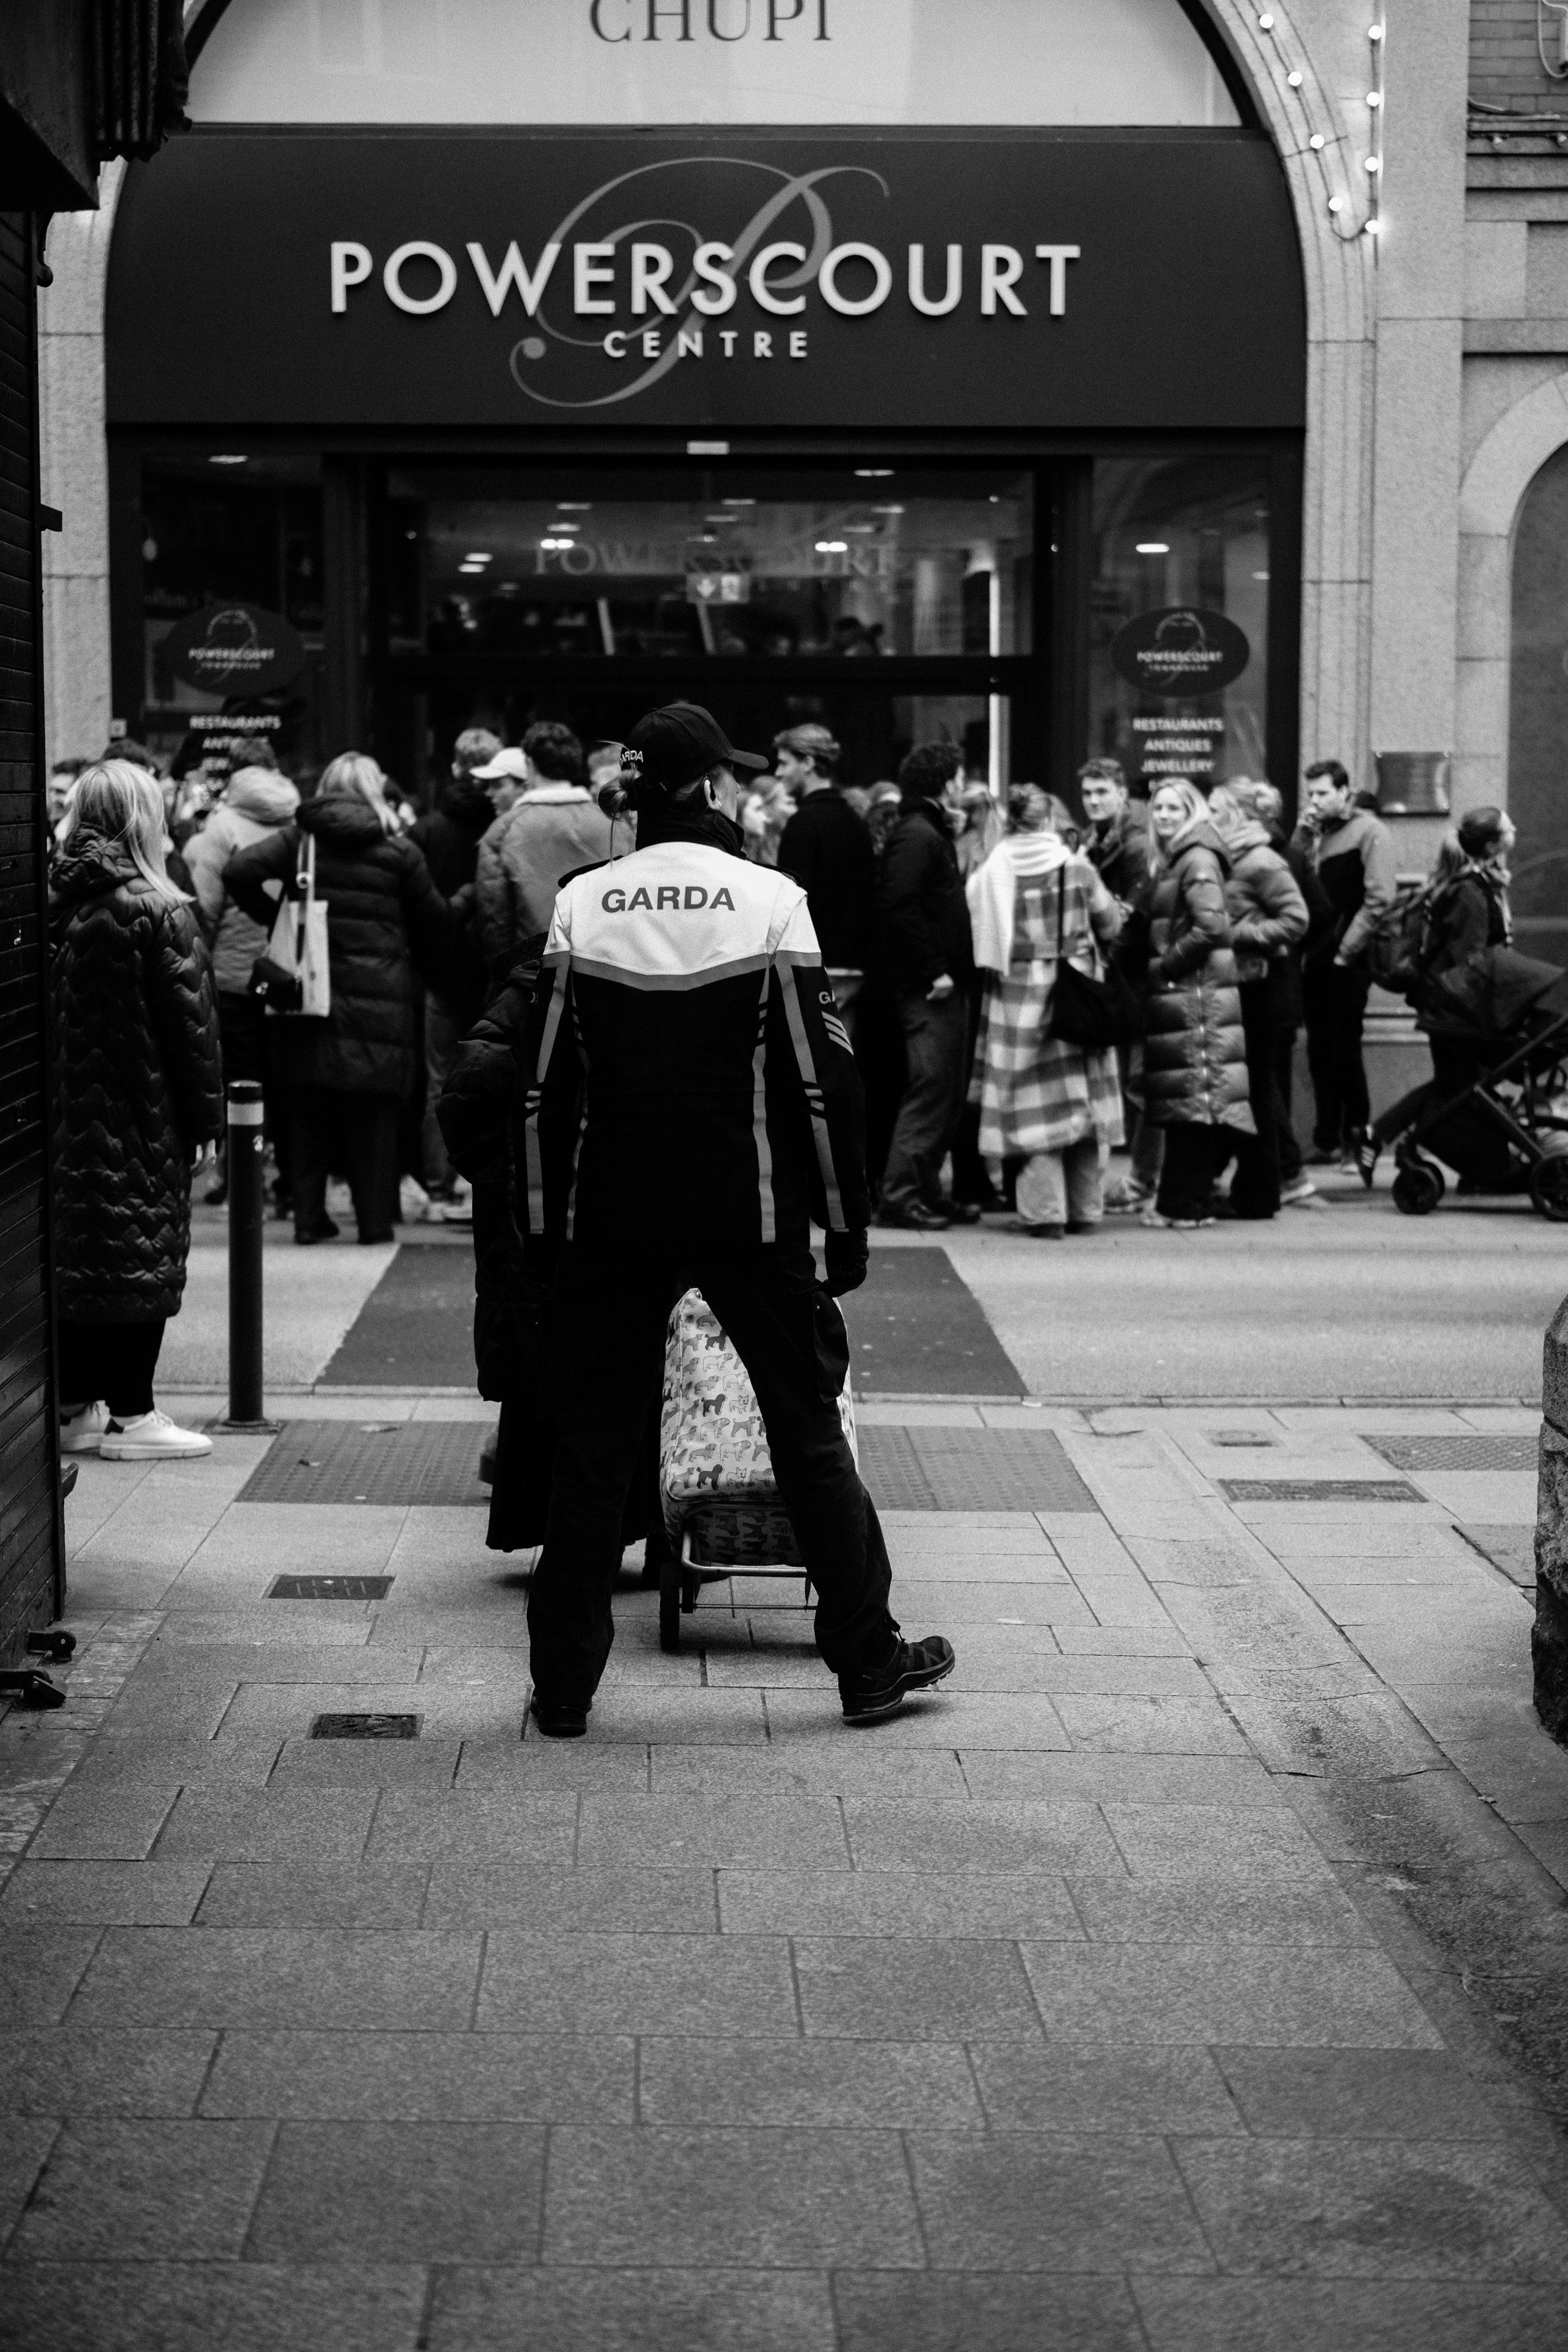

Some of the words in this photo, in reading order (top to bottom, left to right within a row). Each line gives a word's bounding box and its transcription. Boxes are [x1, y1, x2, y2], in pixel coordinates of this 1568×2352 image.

[589, 0, 832, 42] CHUPI
[331, 241, 1080, 317] POWERSCOURT
[603, 330, 808, 358] CENTRE
[1136, 651, 1223, 663] POWERSCOURT
[190, 715, 281, 729] RESTAURANTS
[1132, 717, 1224, 732] RESTAURANTS
[1144, 738, 1213, 752] ANTIQUES
[1140, 758, 1214, 773] JEWELLERY
[601, 886, 736, 914] GARDA
